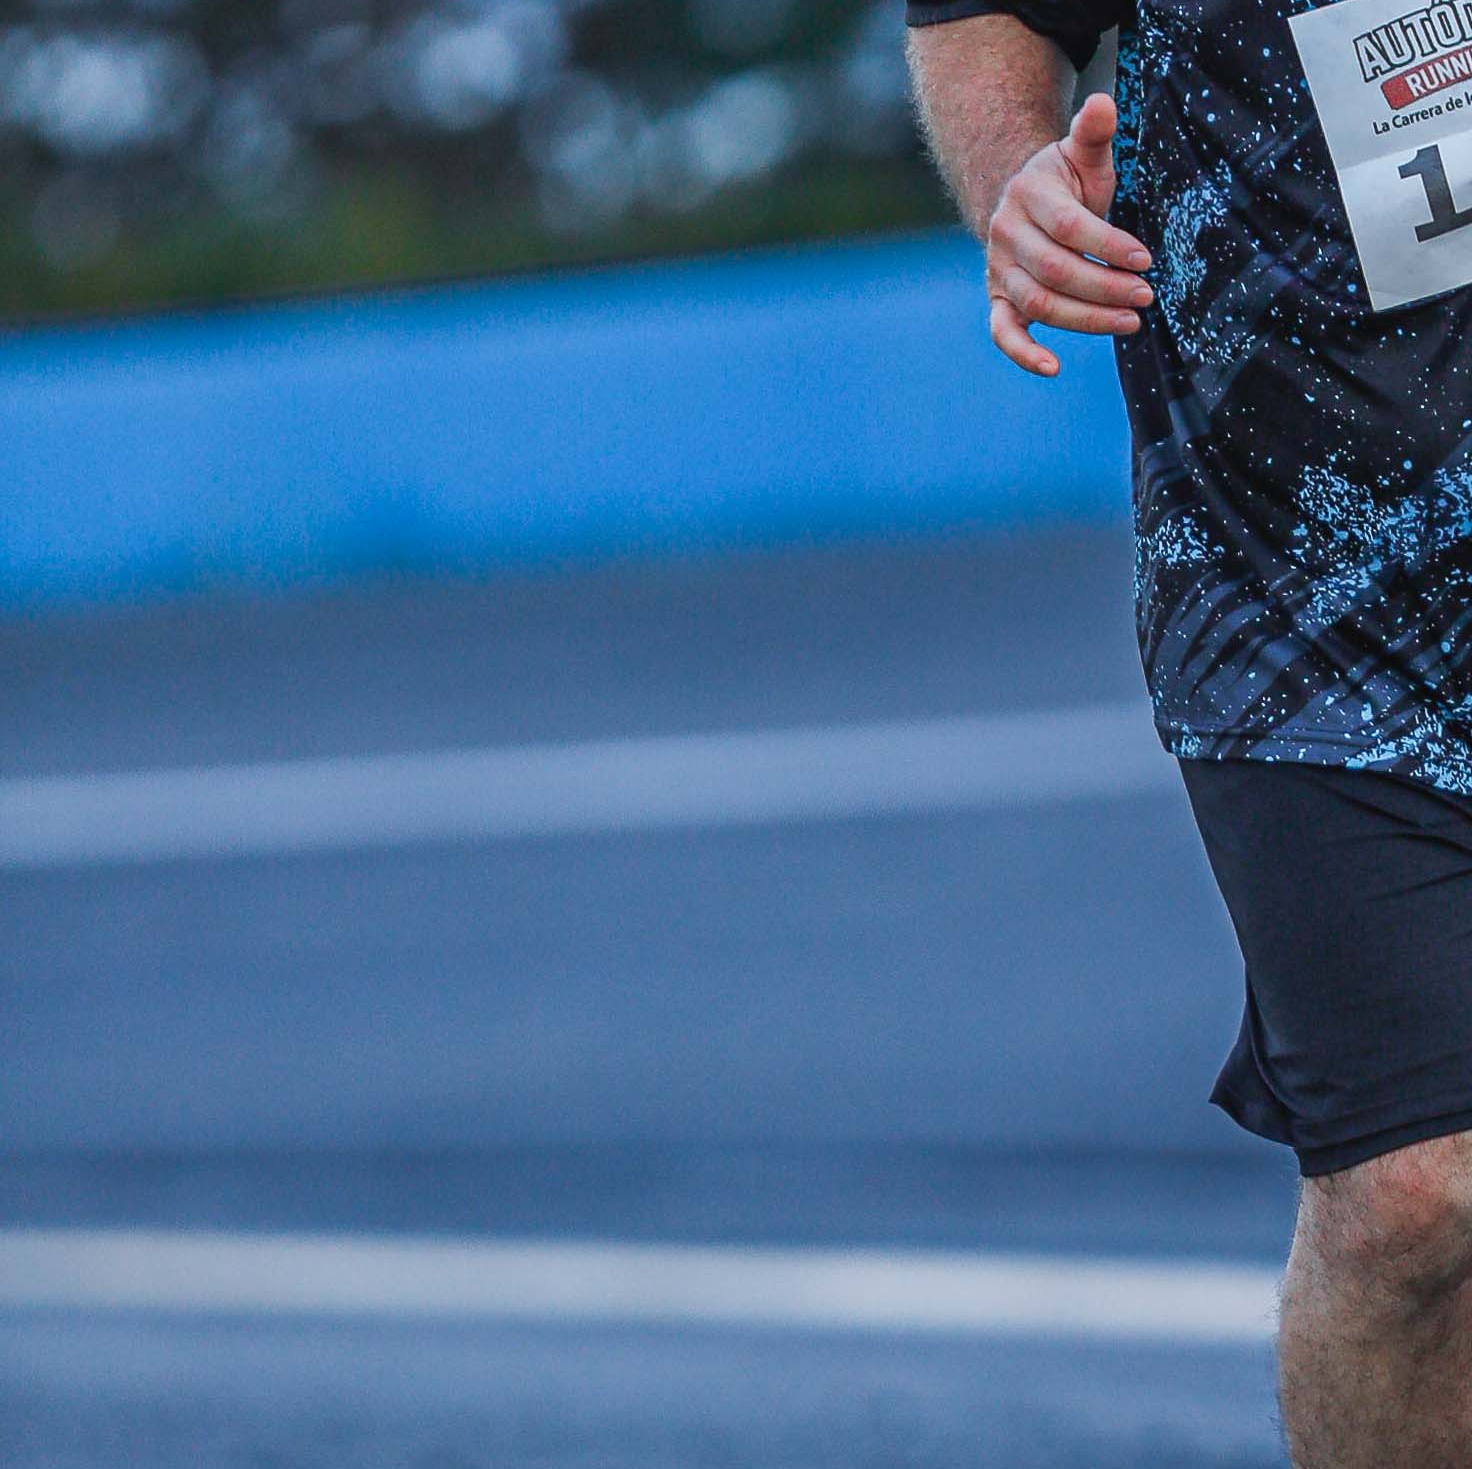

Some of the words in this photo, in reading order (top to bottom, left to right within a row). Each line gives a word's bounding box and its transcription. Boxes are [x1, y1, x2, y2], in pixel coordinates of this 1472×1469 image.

[1373, 119, 1391, 136] La
[1392, 106, 1444, 131] Carrera
[1445, 94, 1464, 114] de
